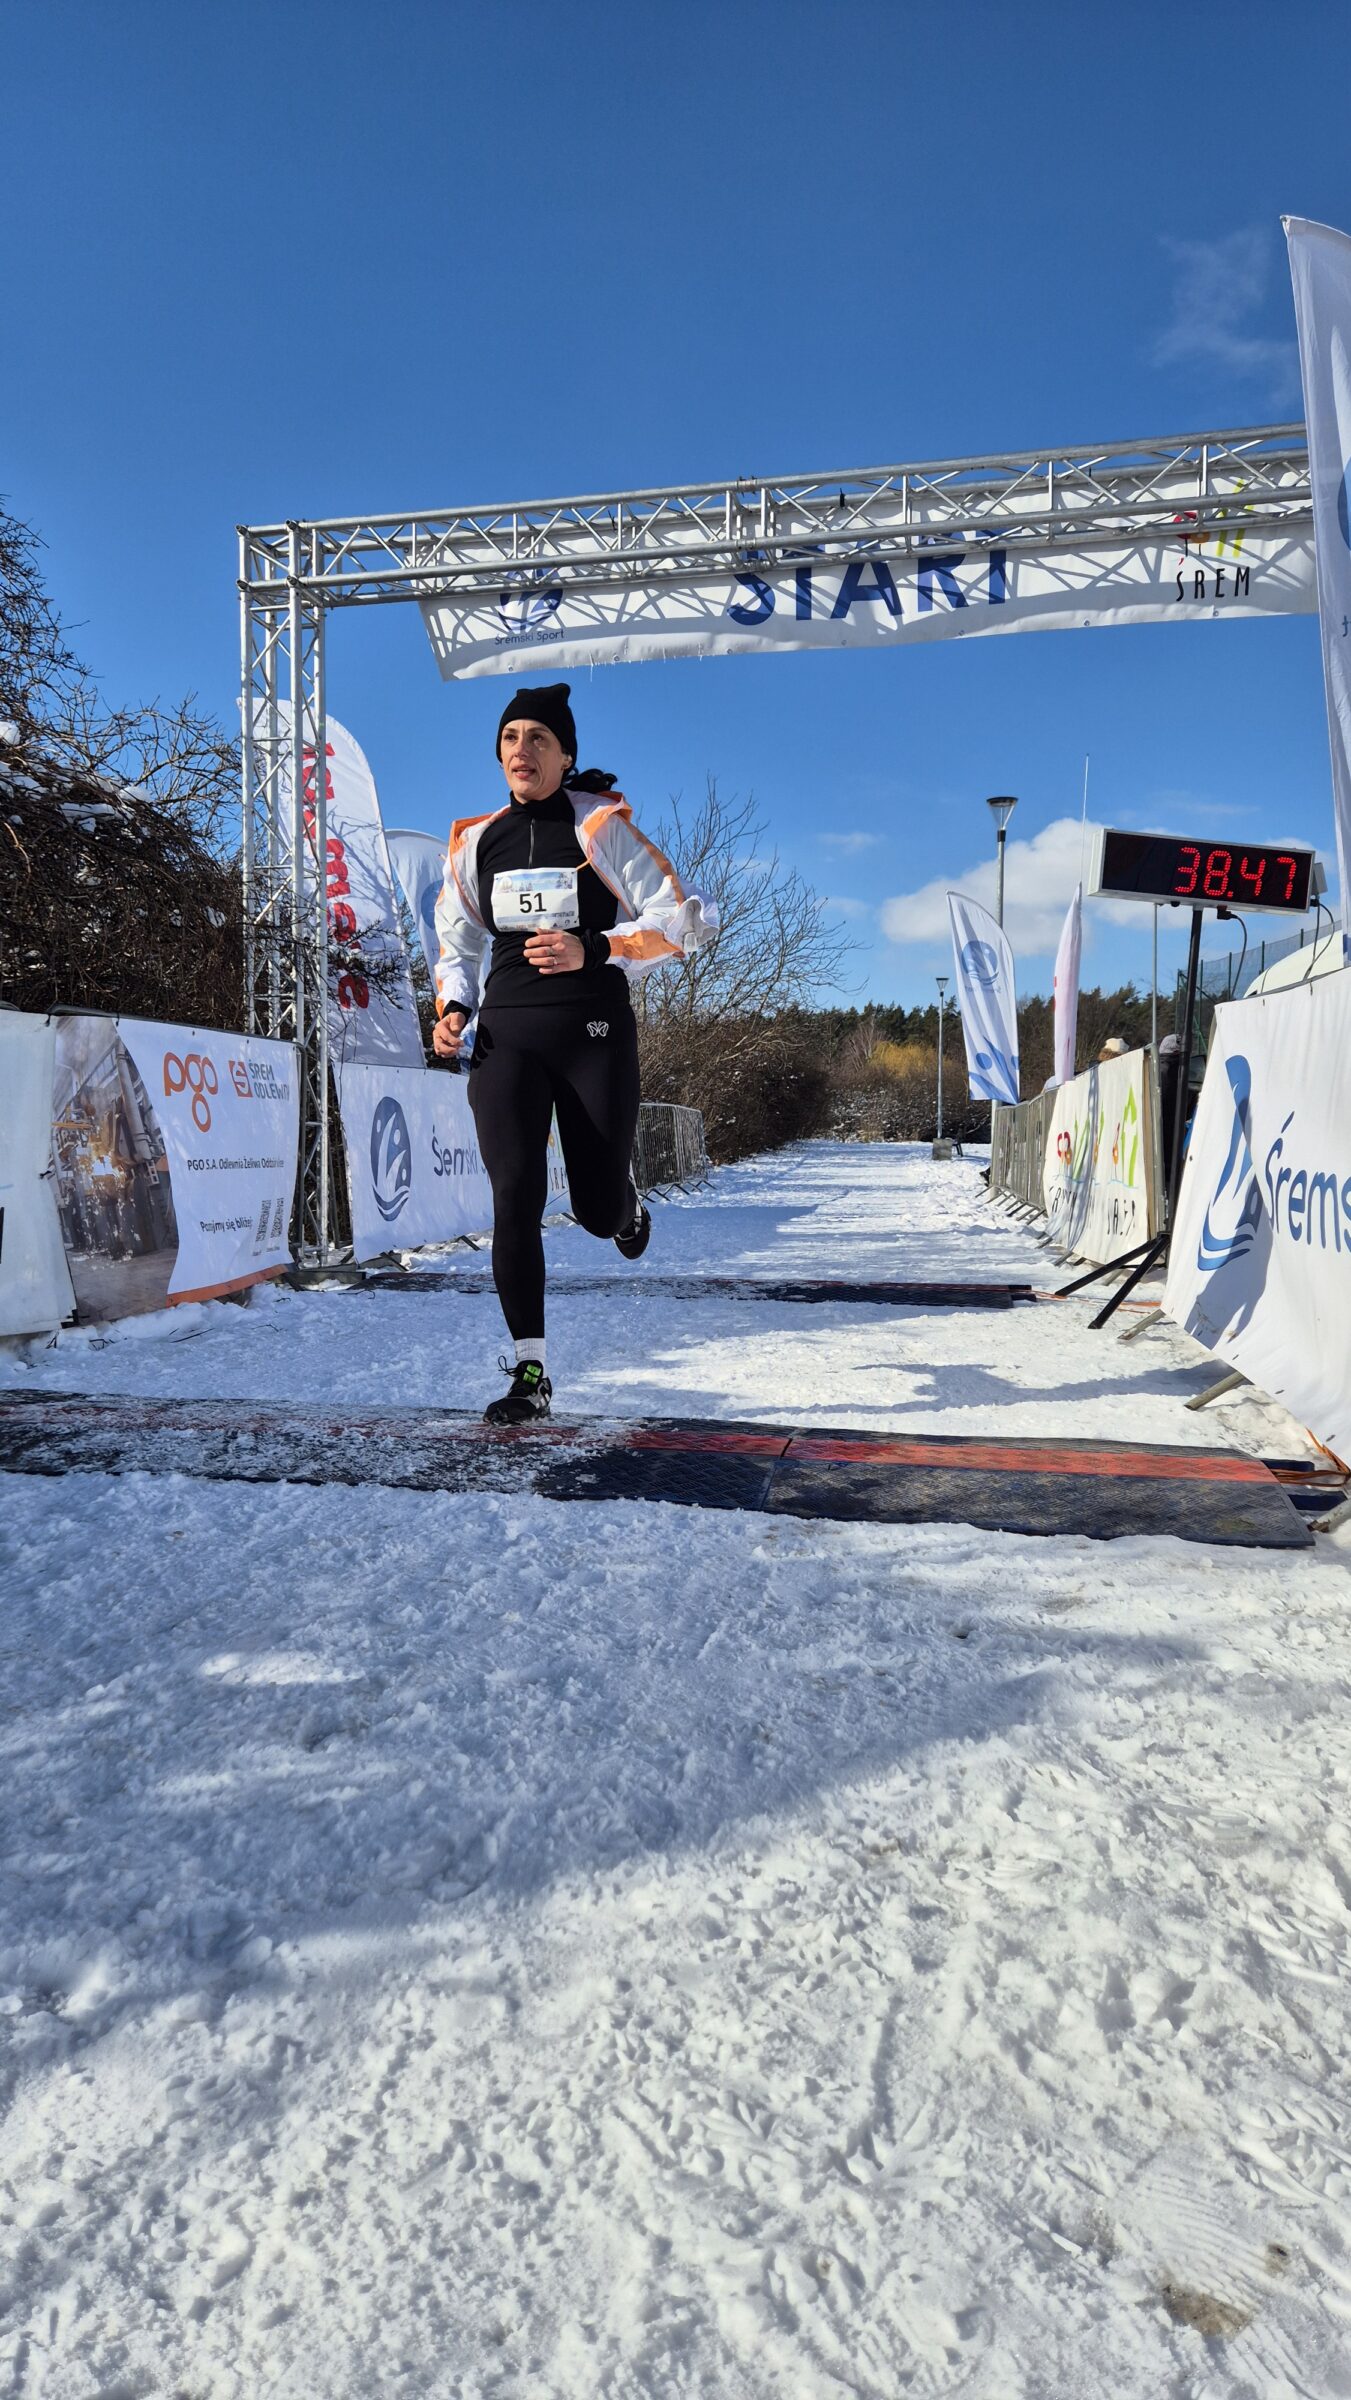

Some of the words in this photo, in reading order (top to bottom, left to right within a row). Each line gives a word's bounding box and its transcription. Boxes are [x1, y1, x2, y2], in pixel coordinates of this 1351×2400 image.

[727, 527, 1012, 626] START
[536, 629, 565, 643] Sport
[1174, 846, 1297, 899] 38.47
[519, 892, 547, 913] 51
[163, 1051, 219, 1132] pgo
[187, 1159, 205, 1171] PGO
[206, 1159, 218, 1169] S.A.
[225, 1218, 236, 1231] się
